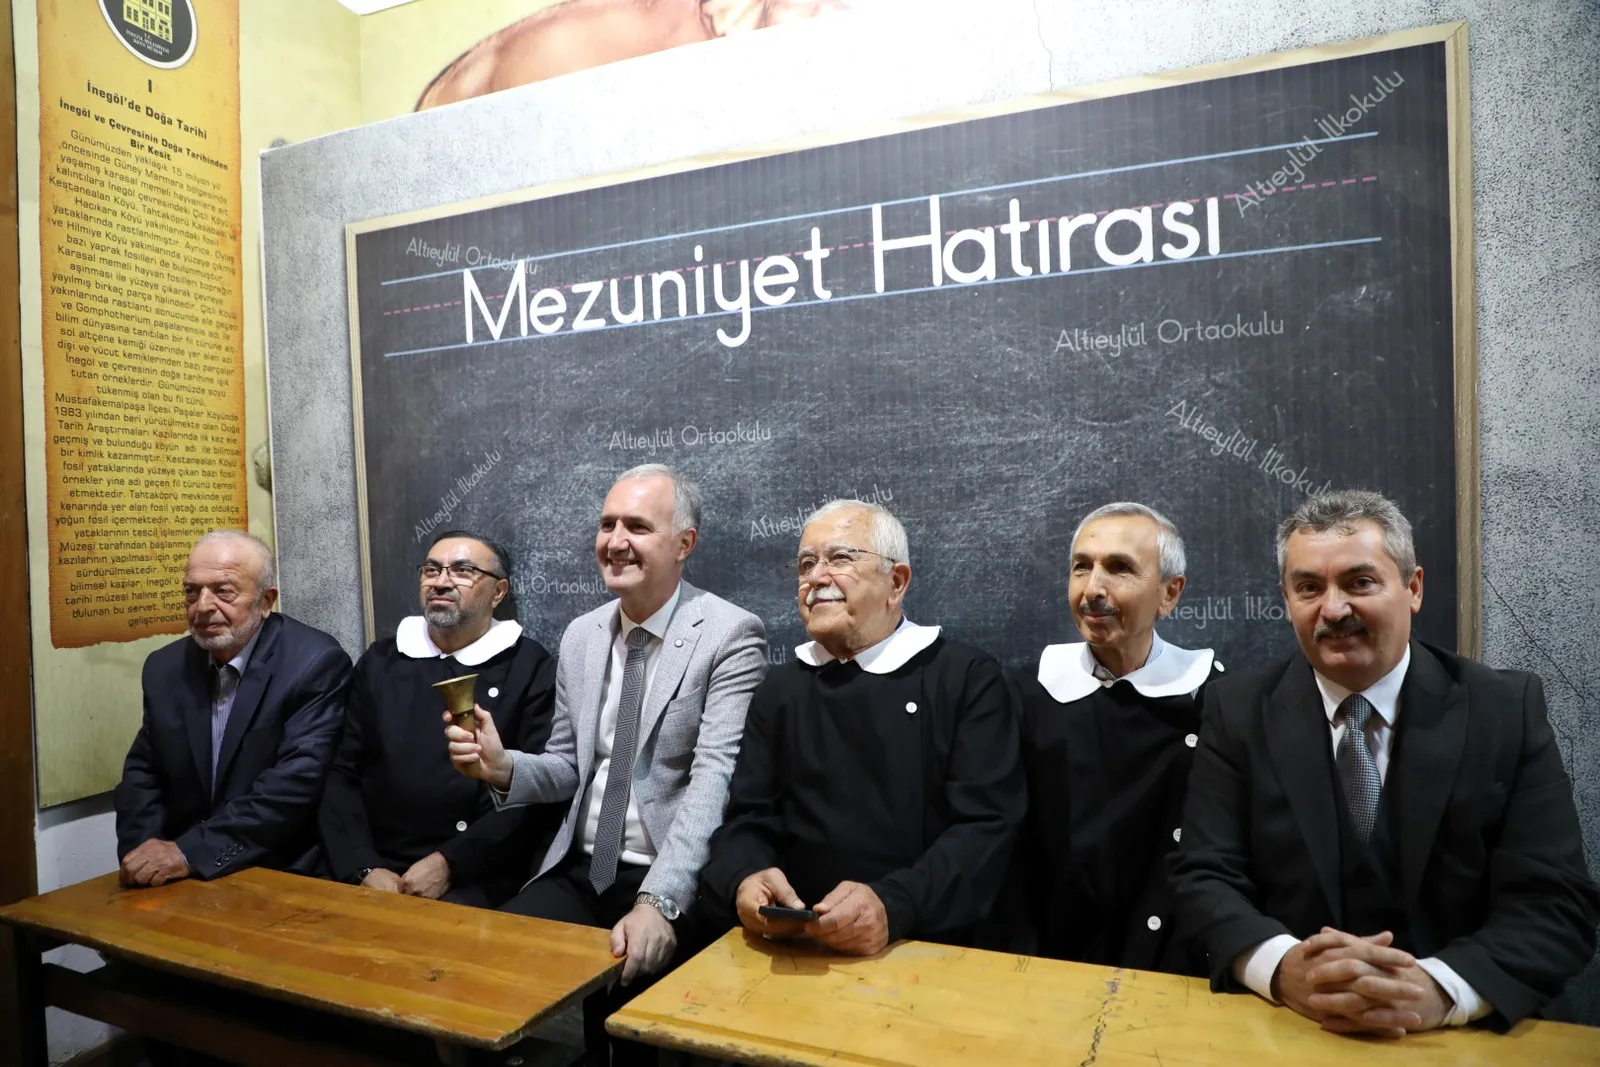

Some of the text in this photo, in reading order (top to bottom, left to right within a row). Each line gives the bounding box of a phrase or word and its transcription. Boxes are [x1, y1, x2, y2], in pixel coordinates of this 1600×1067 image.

[87, 79, 207, 139] İnegöl'de Doğa Tarihi
[59, 96, 228, 170] İnegöl ve Çevresinin Doğa Tarihinden
[70, 128, 131, 159] Günümüzden
[134, 153, 168, 171] yaklaşık
[130, 137, 171, 160] Bir Kesit
[1235, 71, 1405, 218] Altıeylül İlkokulu
[61, 138, 111, 164] öncesinde
[113, 156, 141, 177] Güney
[60, 154, 170, 196] yaşamış karasal memeli
[107, 177, 135, 197] İnegöl
[75, 195, 142, 225] Hacıkara Köyü
[66, 218, 102, 239] Hilmiye
[105, 229, 127, 246] Köyü
[66, 232, 86, 247] bazı
[90, 241, 120, 255] yaprak
[123, 247, 156, 264] fosilleri
[406, 237, 538, 275] Altıeylül Ortaoklu
[57, 243, 96, 262] Karasal
[99, 256, 132, 271] memeli
[134, 263, 164, 279] hayvan
[463, 194, 1221, 348] Mezuniyet Hatırası
[52, 272, 152, 302] yayılmış birkaç parça
[69, 262, 113, 279] aşınması
[129, 275, 158, 291] yüzeye
[112, 298, 152, 313] rastlantı
[55, 310, 79, 324] bilim
[82, 316, 129, 334] dünyasına
[132, 326, 168, 341] tanıtılan
[1055, 310, 1285, 357] Altıeylül Ortaokulu
[57, 338, 75, 352] dişi
[92, 344, 119, 357] vücut
[78, 329, 114, 344] altçene
[117, 335, 146, 351] kemiği
[65, 350, 95, 368] İnegöl
[111, 362, 157, 375] çevresinin
[71, 367, 98, 380] tutan
[96, 384, 139, 400] tükenmiş
[141, 390, 160, 400] olan
[54, 405, 81, 417] 1983
[85, 409, 120, 421] yılından
[123, 412, 141, 423] beri
[148, 400, 170, 414] İlçesi
[173, 405, 204, 418] Paşalar
[58, 419, 83, 430] Tarih
[52, 434, 89, 446] geçmiş
[106, 436, 152, 451] bulunduğu
[155, 440, 179, 453] köyün
[608, 420, 772, 457] Altıeylül Ortaokulu
[1164, 399, 1332, 498] Altıeylül İlkokul
[78, 447, 104, 458] kimlik
[62, 460, 84, 470] fosil
[147, 465, 175, 478] yüzeye
[178, 467, 199, 477] çıkan
[62, 473, 103, 484] örnekler
[106, 475, 125, 487] yine
[144, 479, 170, 489] geçen
[129, 489, 178, 502] Tahtaköprü
[415, 450, 502, 543] Altıeylül İlkokulu
[60, 500, 108, 510] kenarında
[128, 502, 147, 511] alan
[150, 502, 168, 511] fosil
[171, 503, 196, 514] yatağı
[55, 513, 84, 526] yoğun
[88, 514, 108, 523] fosil
[132, 527, 157, 536] tescil
[59, 540, 96, 551] Müzesi
[98, 540, 147, 550] tarafından
[149, 540, 192, 551] başlanmış
[110, 553, 151, 565] yapılması
[155, 552, 170, 563] için
[70, 579, 107, 591] bilimsel
[531, 574, 609, 595] Ortaokulu
[65, 590, 157, 604] tarihi müzesi haline
[72, 606, 110, 617] bulunan
